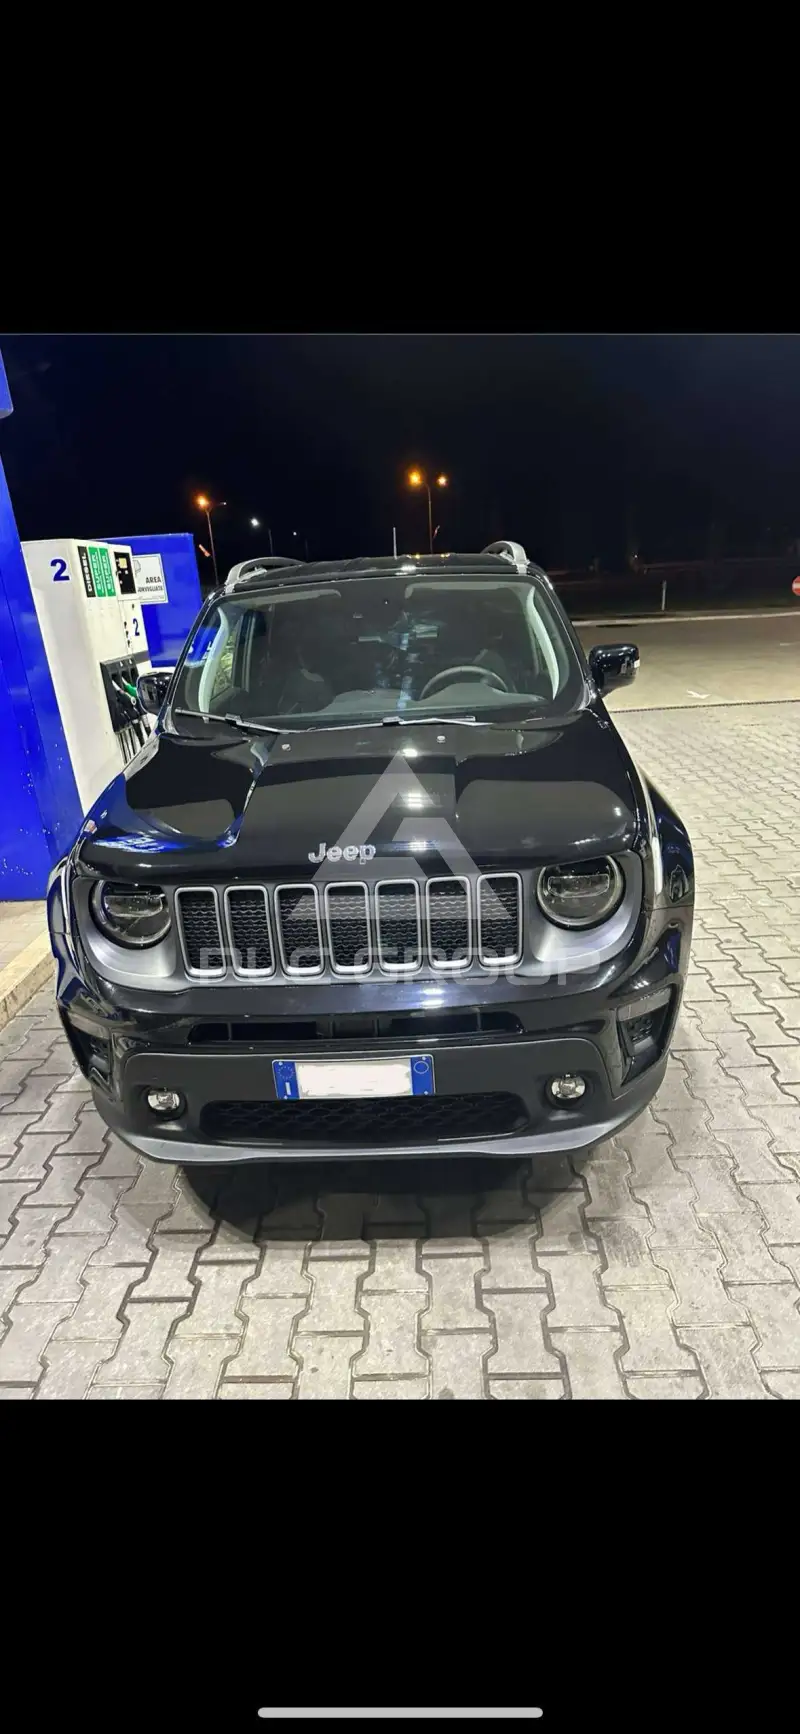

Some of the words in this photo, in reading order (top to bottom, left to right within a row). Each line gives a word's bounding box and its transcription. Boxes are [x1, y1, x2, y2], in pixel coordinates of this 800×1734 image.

[50, 558, 70, 582] 2
[81, 552, 93, 592] DIESEL
[145, 576, 162, 584] AREA
[132, 617, 141, 637] 2
[308, 842, 377, 865] Jeep
